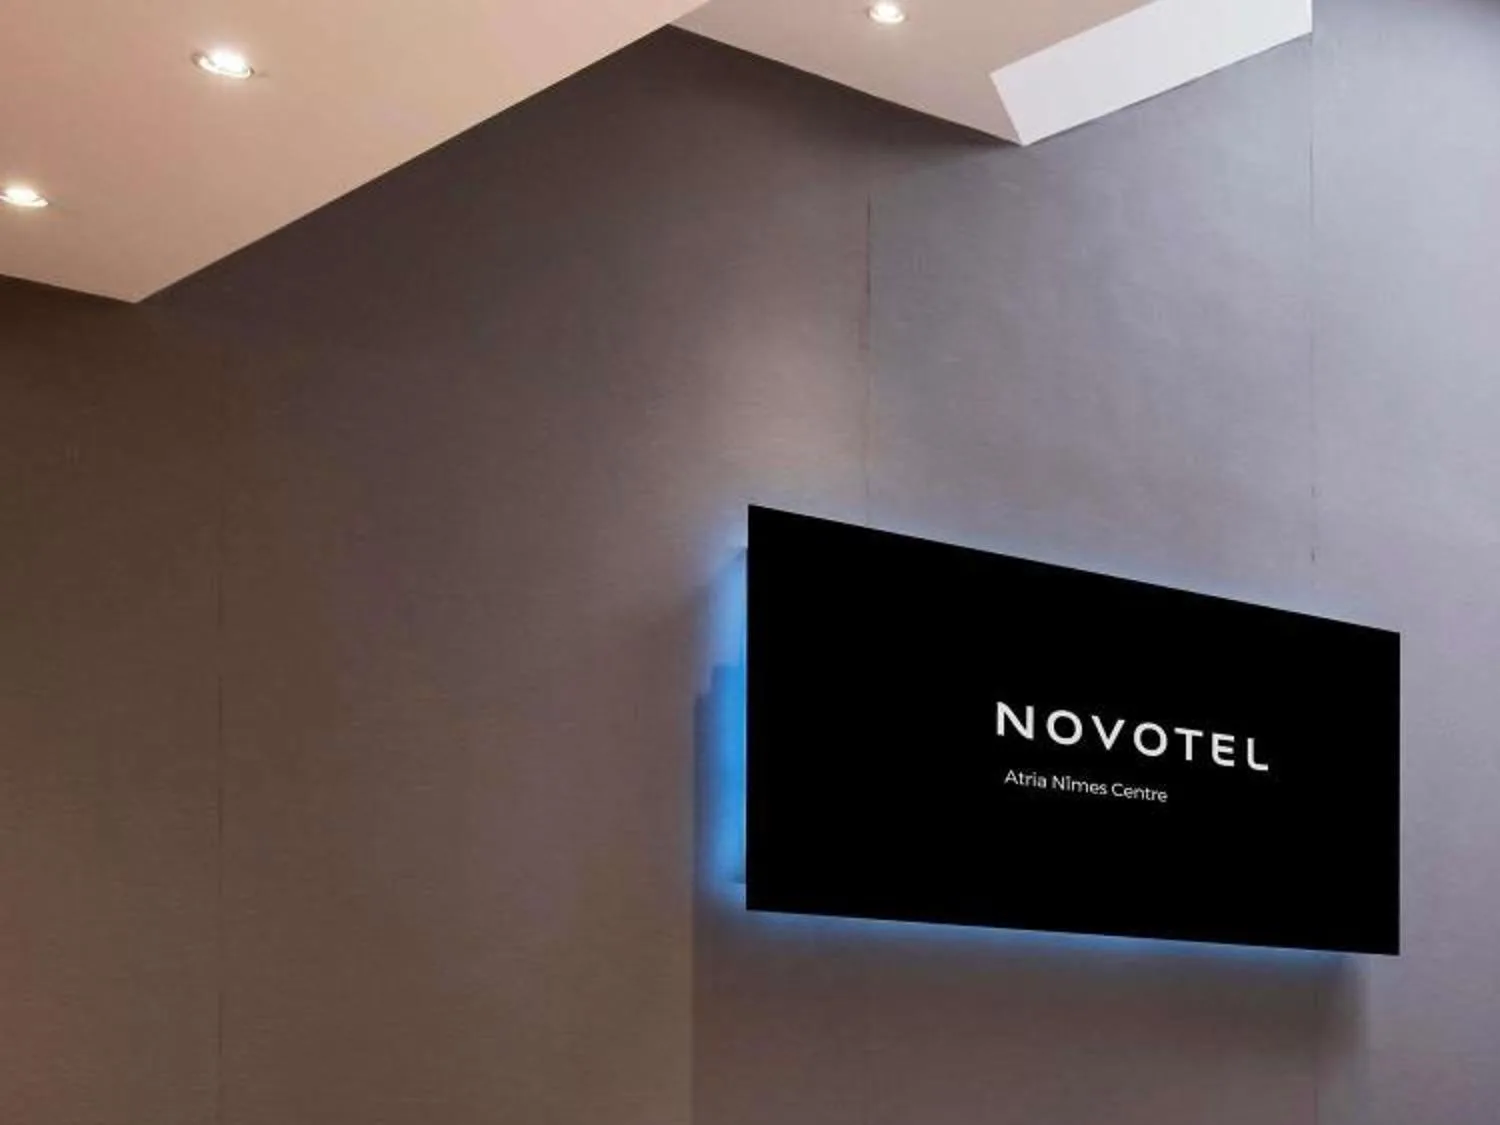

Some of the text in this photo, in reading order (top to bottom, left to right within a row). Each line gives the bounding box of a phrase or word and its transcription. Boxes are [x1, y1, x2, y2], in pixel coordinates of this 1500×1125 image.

[996, 701, 1269, 772] NOVOTEL
[1004, 769, 1047, 789] Atria
[1111, 782, 1168, 803] Centre
